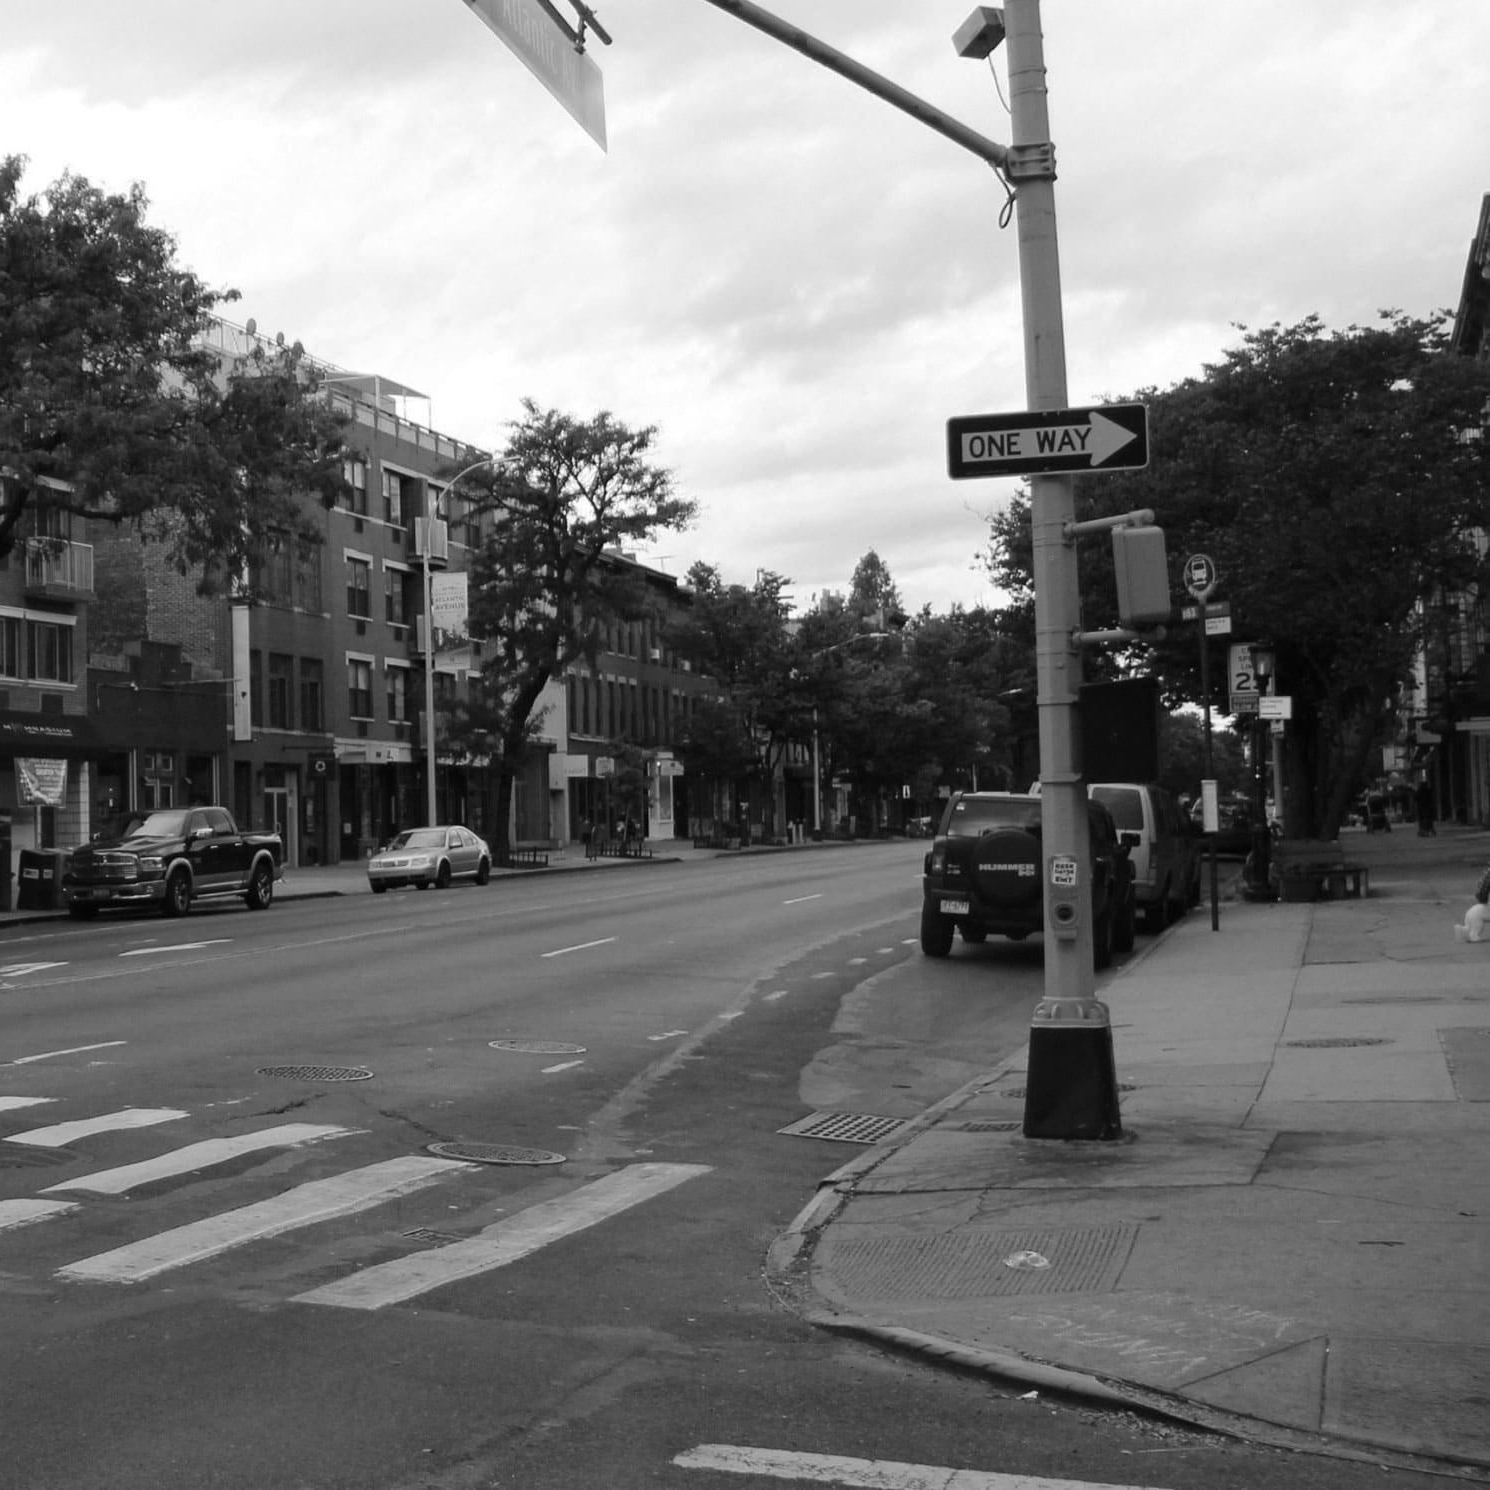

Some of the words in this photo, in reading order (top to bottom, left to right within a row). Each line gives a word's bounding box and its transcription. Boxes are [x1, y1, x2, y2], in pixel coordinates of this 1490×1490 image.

[969, 432, 1022, 459] ONE
[1036, 426, 1092, 454] WAY
[978, 863, 1035, 871] HUMMER
